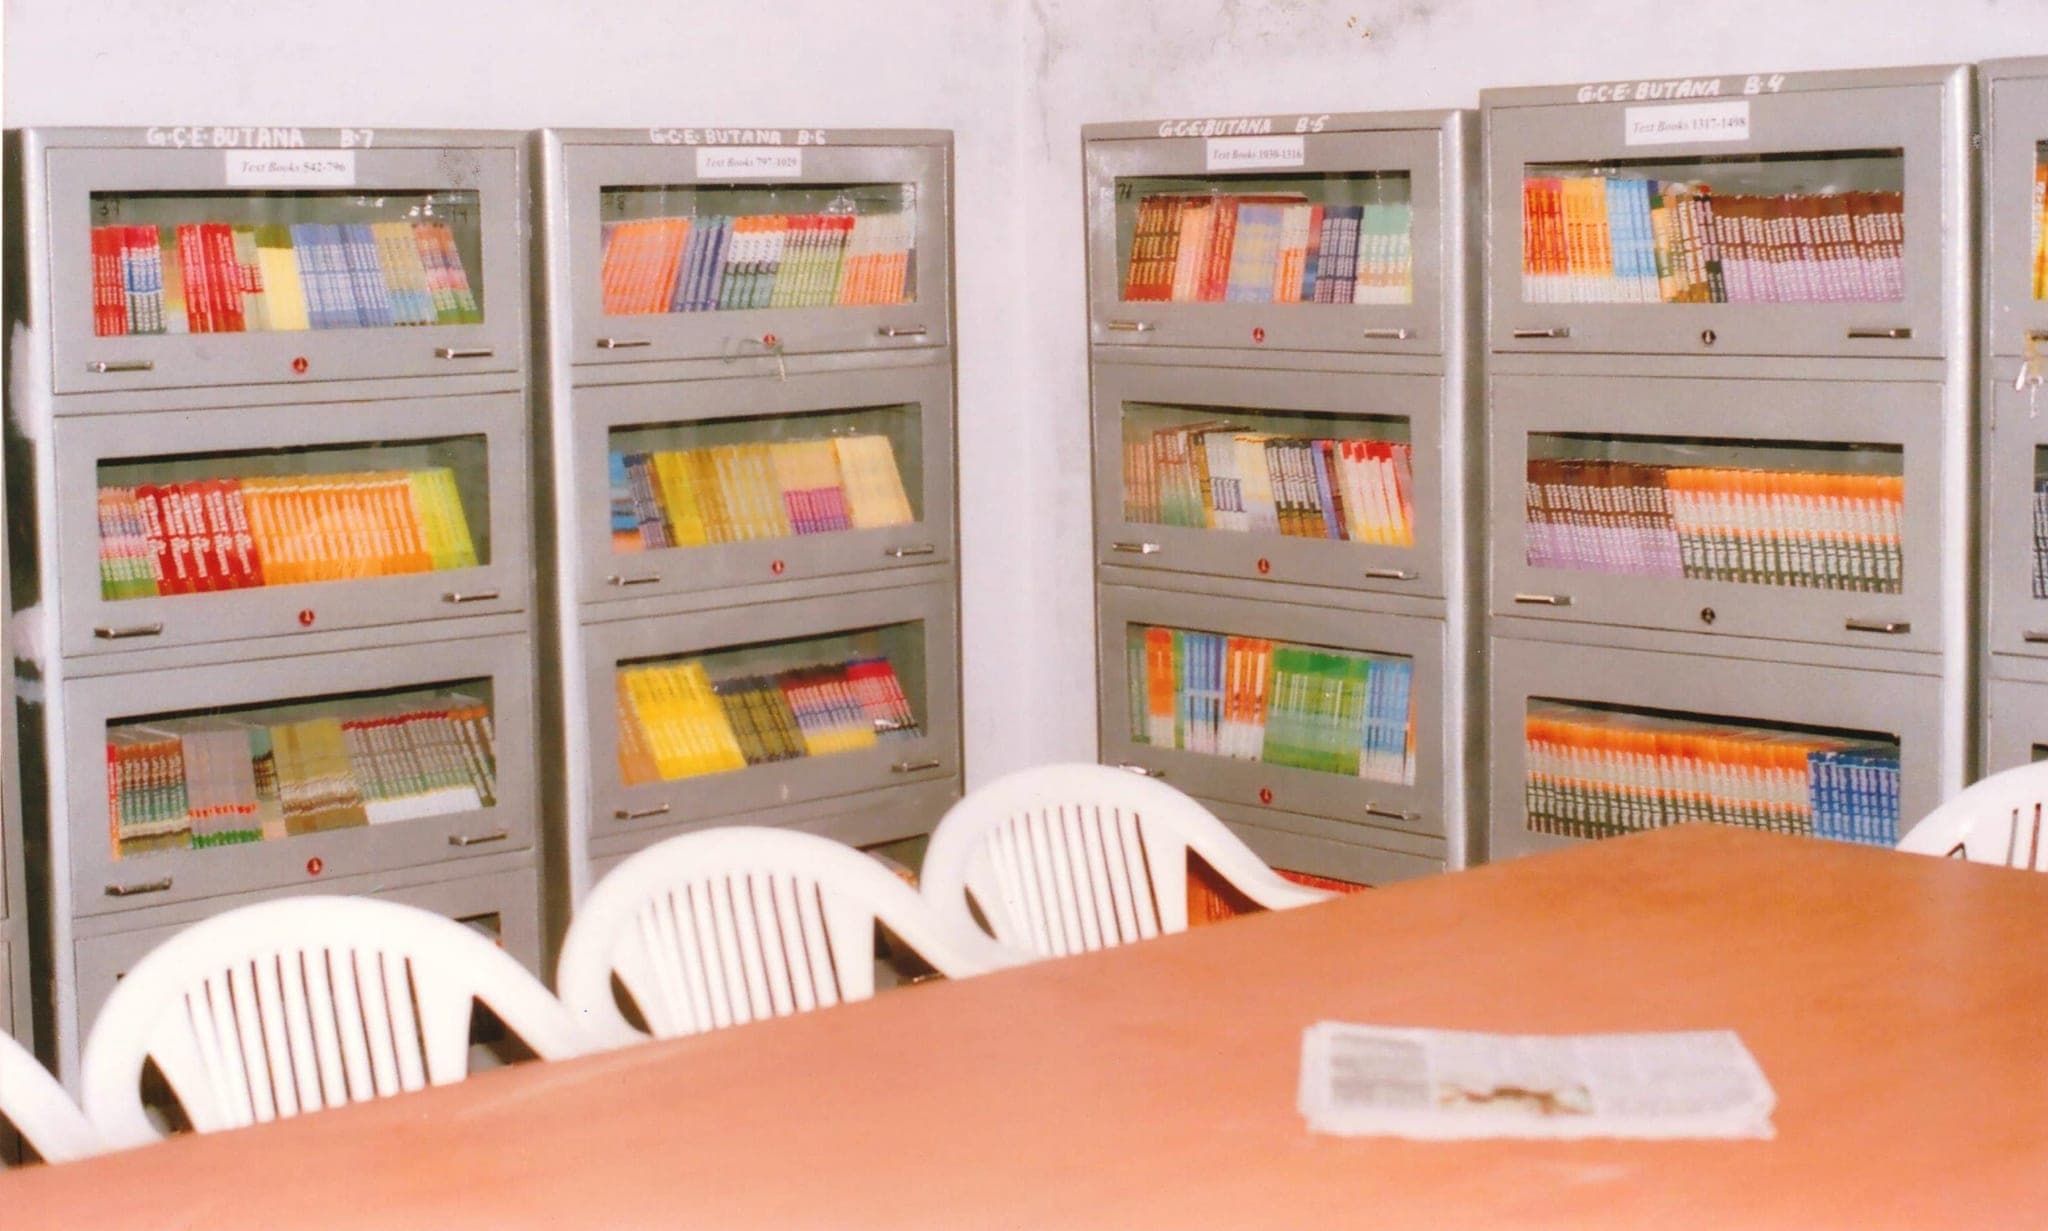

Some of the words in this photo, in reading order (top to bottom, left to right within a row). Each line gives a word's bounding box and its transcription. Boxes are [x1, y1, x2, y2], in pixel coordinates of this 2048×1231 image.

[1635, 79, 1720, 100] BUTANA
[1202, 118, 1272, 136] BUTANA
[1633, 121, 1654, 133] Text
[1656, 120, 1689, 132] Books
[1692, 116, 1746, 130] 1317-1498
[213, 127, 304, 148] BUTANA
[704, 129, 782, 146] BUTANA
[704, 156, 726, 168] Text
[727, 156, 754, 168] Books
[1213, 149, 1231, 160] Text
[1232, 148, 1257, 160] Books
[242, 160, 266, 173] Text
[268, 160, 300, 173] Books
[302, 160, 347, 174] 542-796
